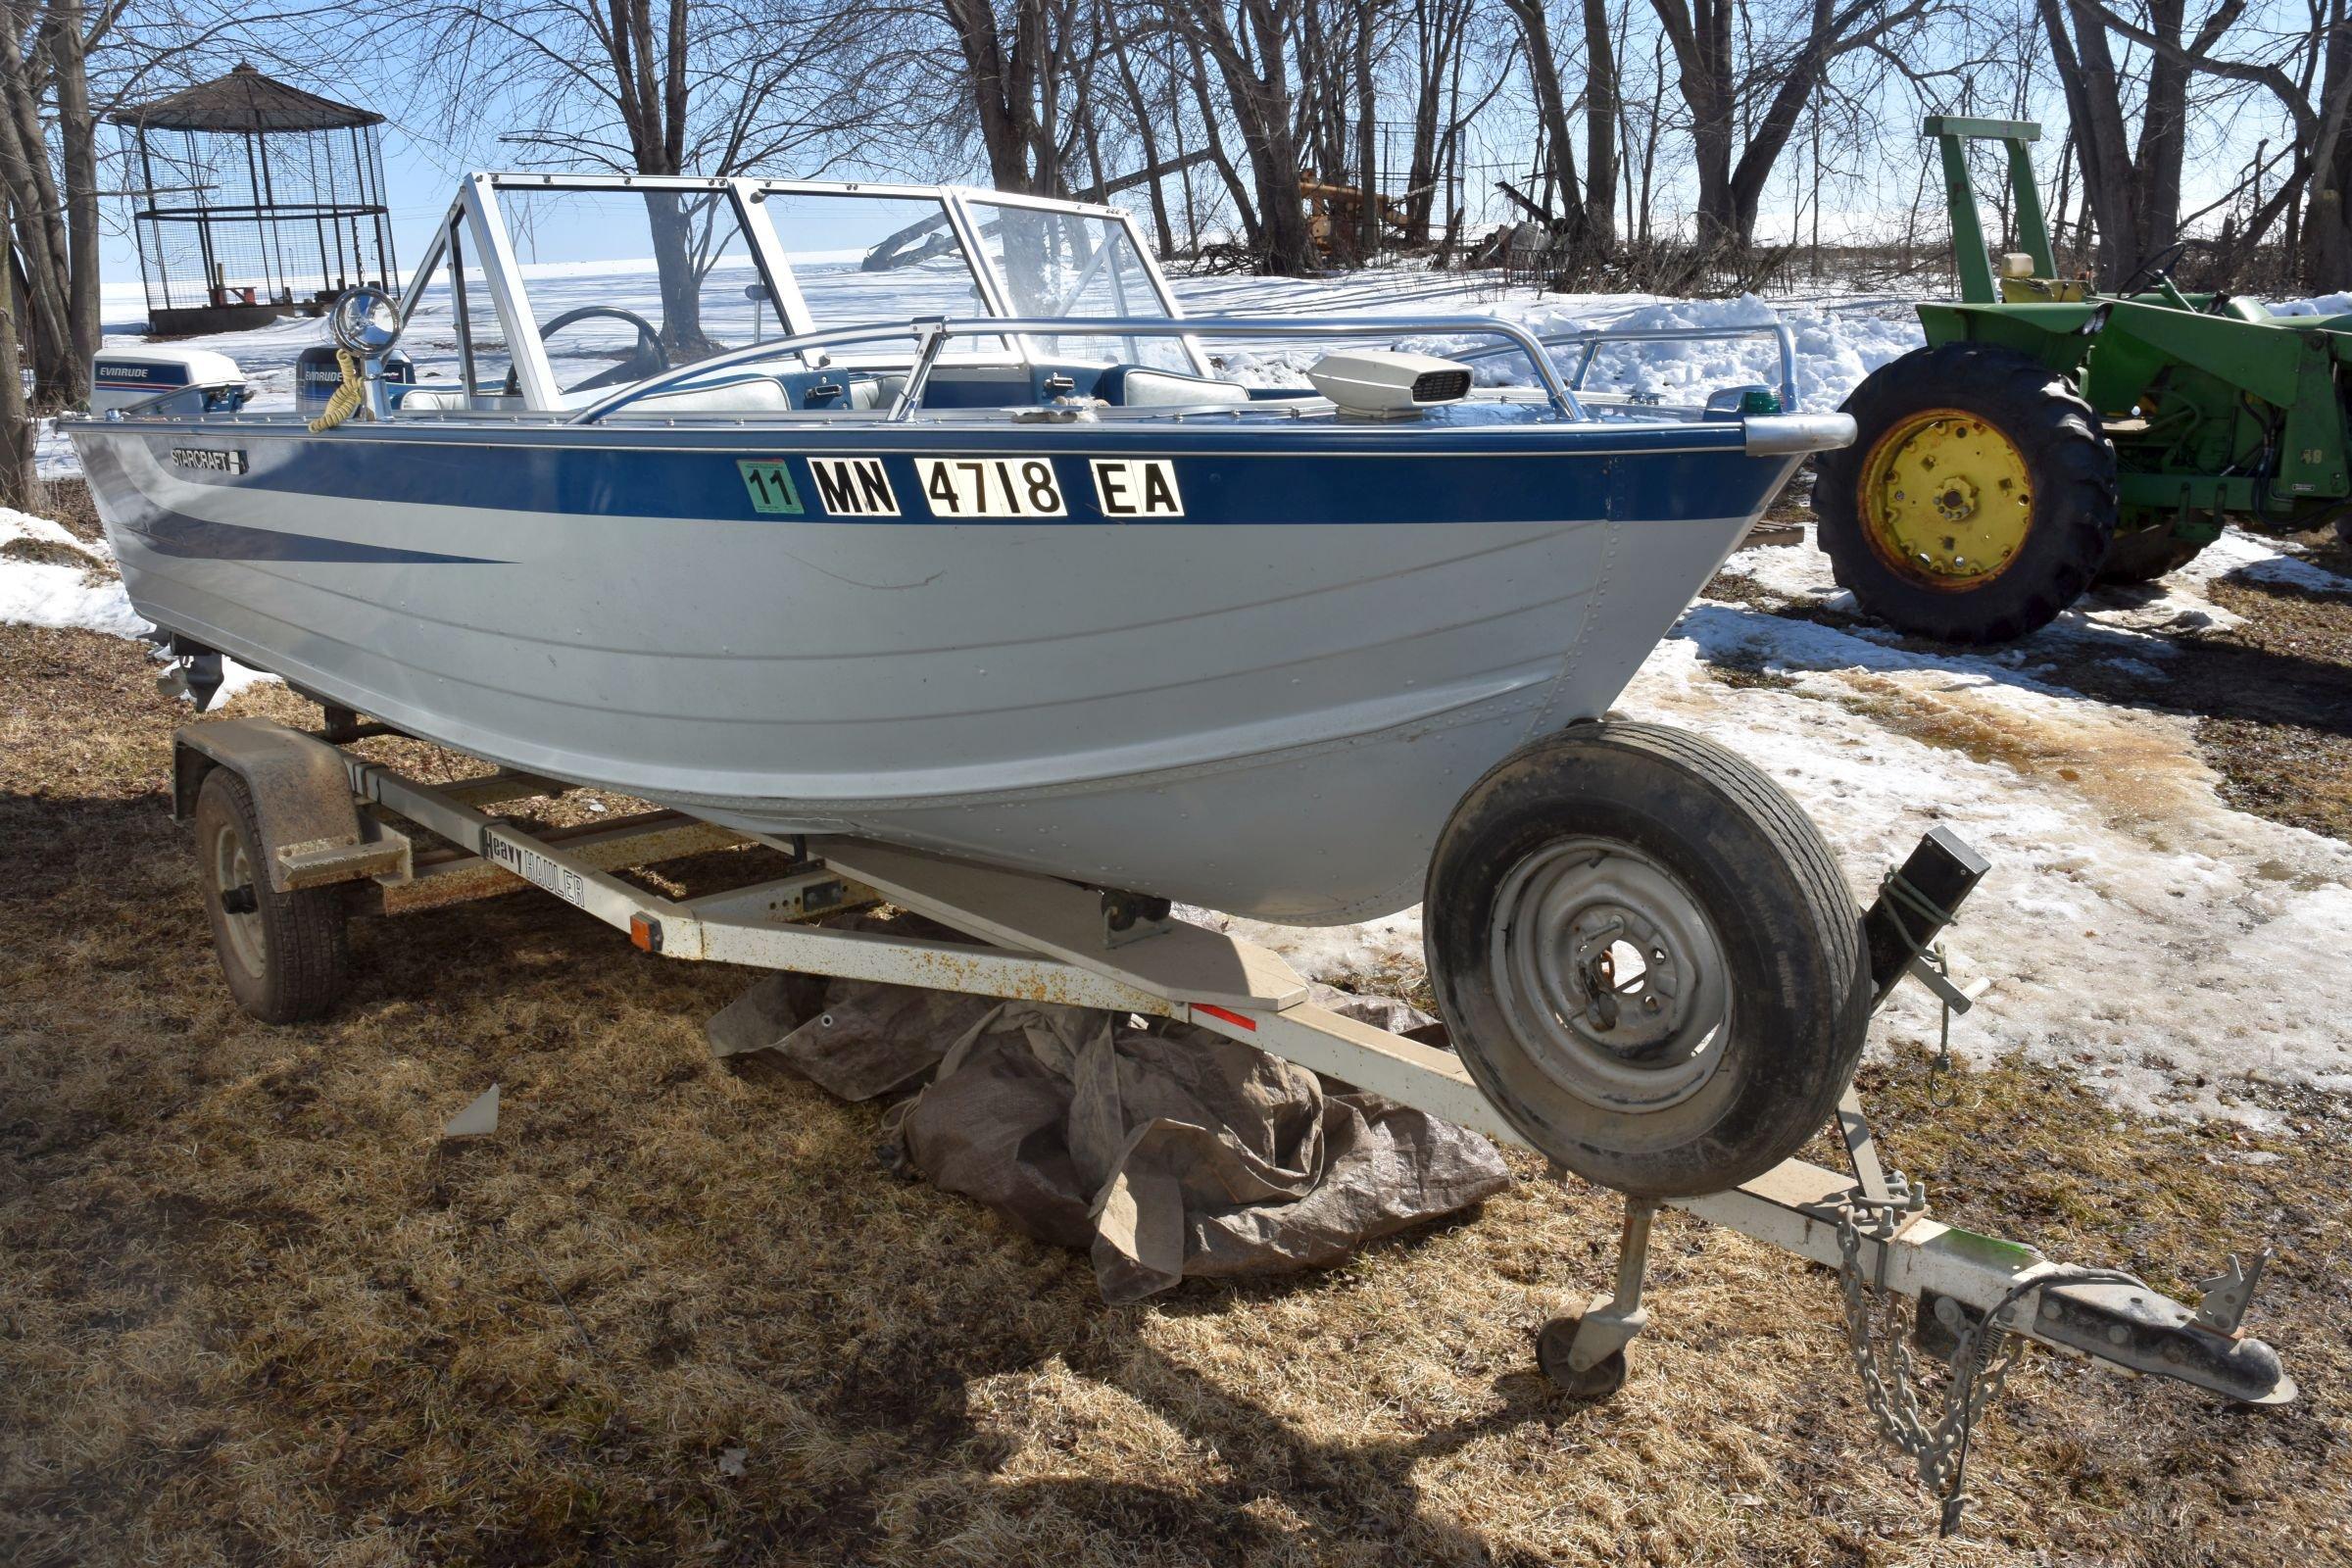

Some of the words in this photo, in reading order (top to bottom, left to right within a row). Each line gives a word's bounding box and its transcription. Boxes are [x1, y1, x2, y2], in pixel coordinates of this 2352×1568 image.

[100, 368, 148, 377] EVINRUDE
[172, 450, 226, 470] STARCRAFT
[749, 469, 792, 505] 11
[811, 461, 896, 513] MN
[929, 461, 1060, 514] 4718
[1096, 463, 1179, 514] EA
[485, 831, 522, 874] Heavy
[524, 850, 585, 908] HAULER
